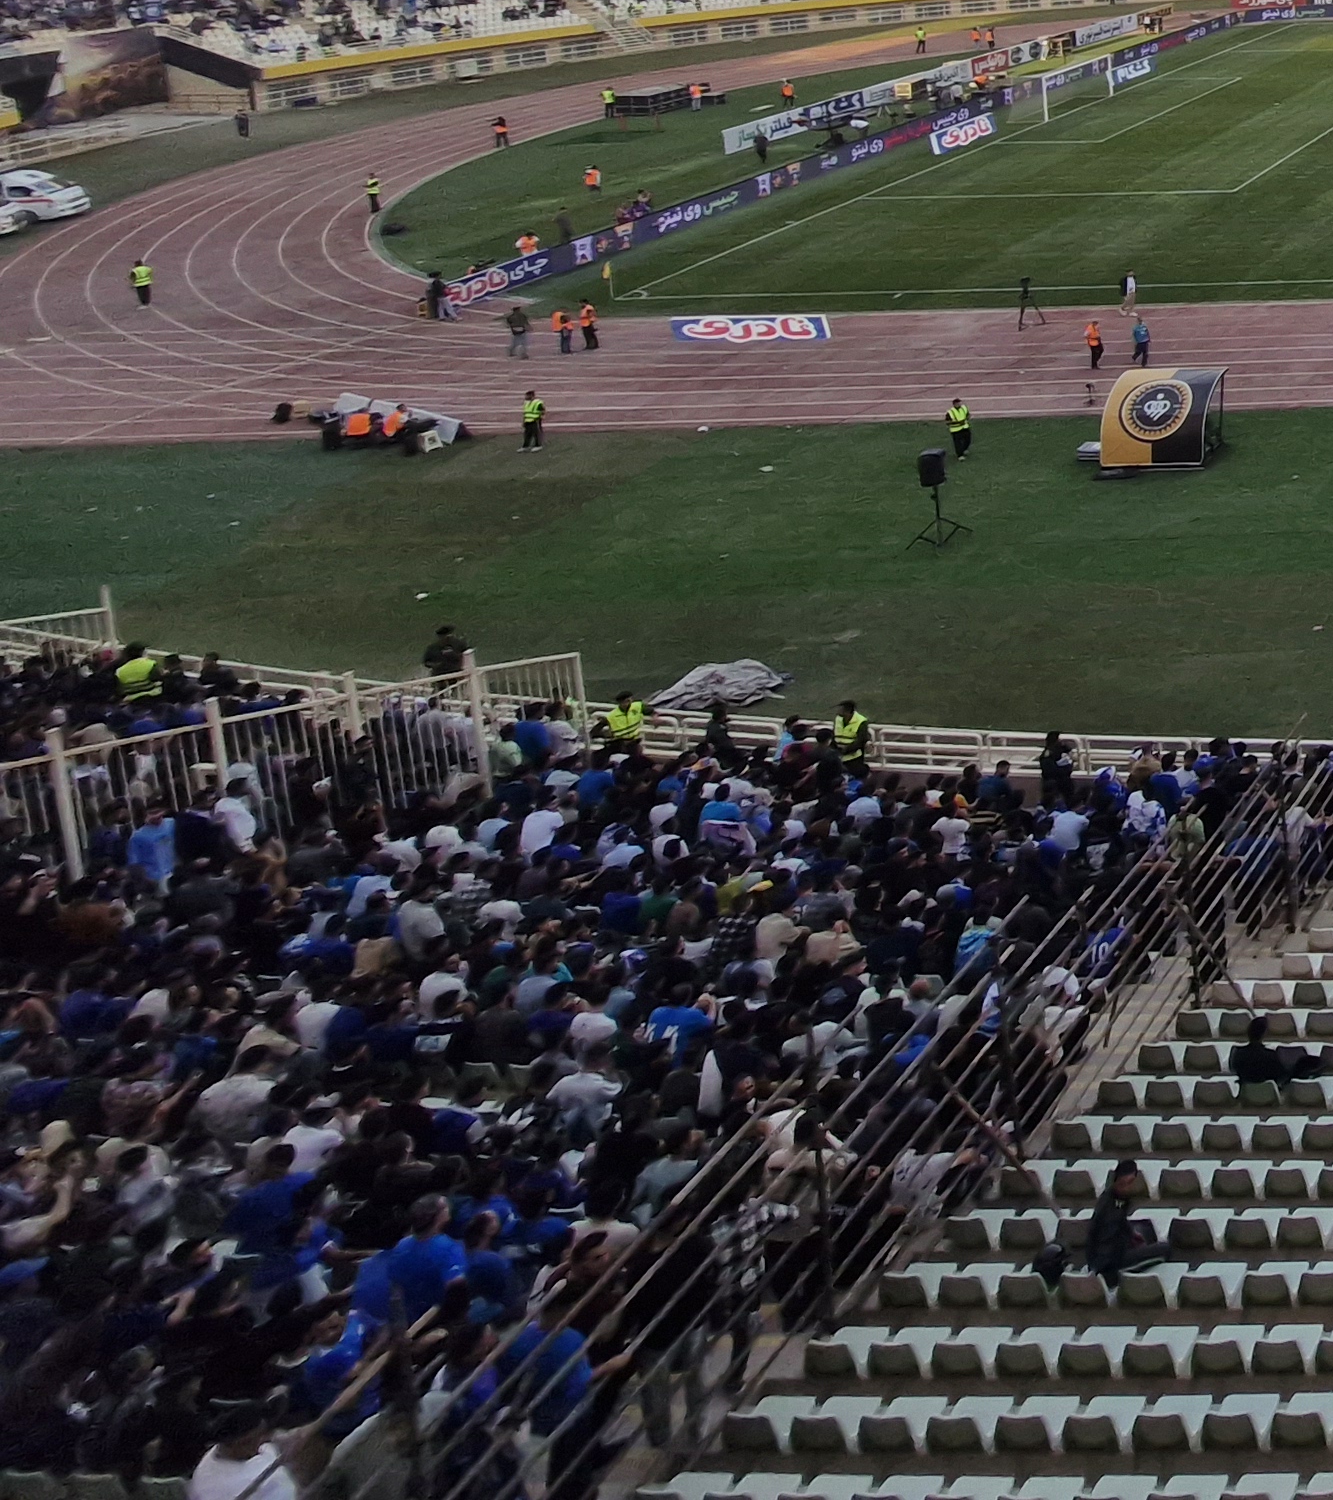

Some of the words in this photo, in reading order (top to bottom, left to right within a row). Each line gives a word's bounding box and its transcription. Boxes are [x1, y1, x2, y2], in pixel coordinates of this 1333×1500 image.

[768, 112, 794, 139] فیلتر
[941, 117, 993, 149] نادری
[509, 257, 550, 282] چای
[685, 316, 816, 342] نادری
